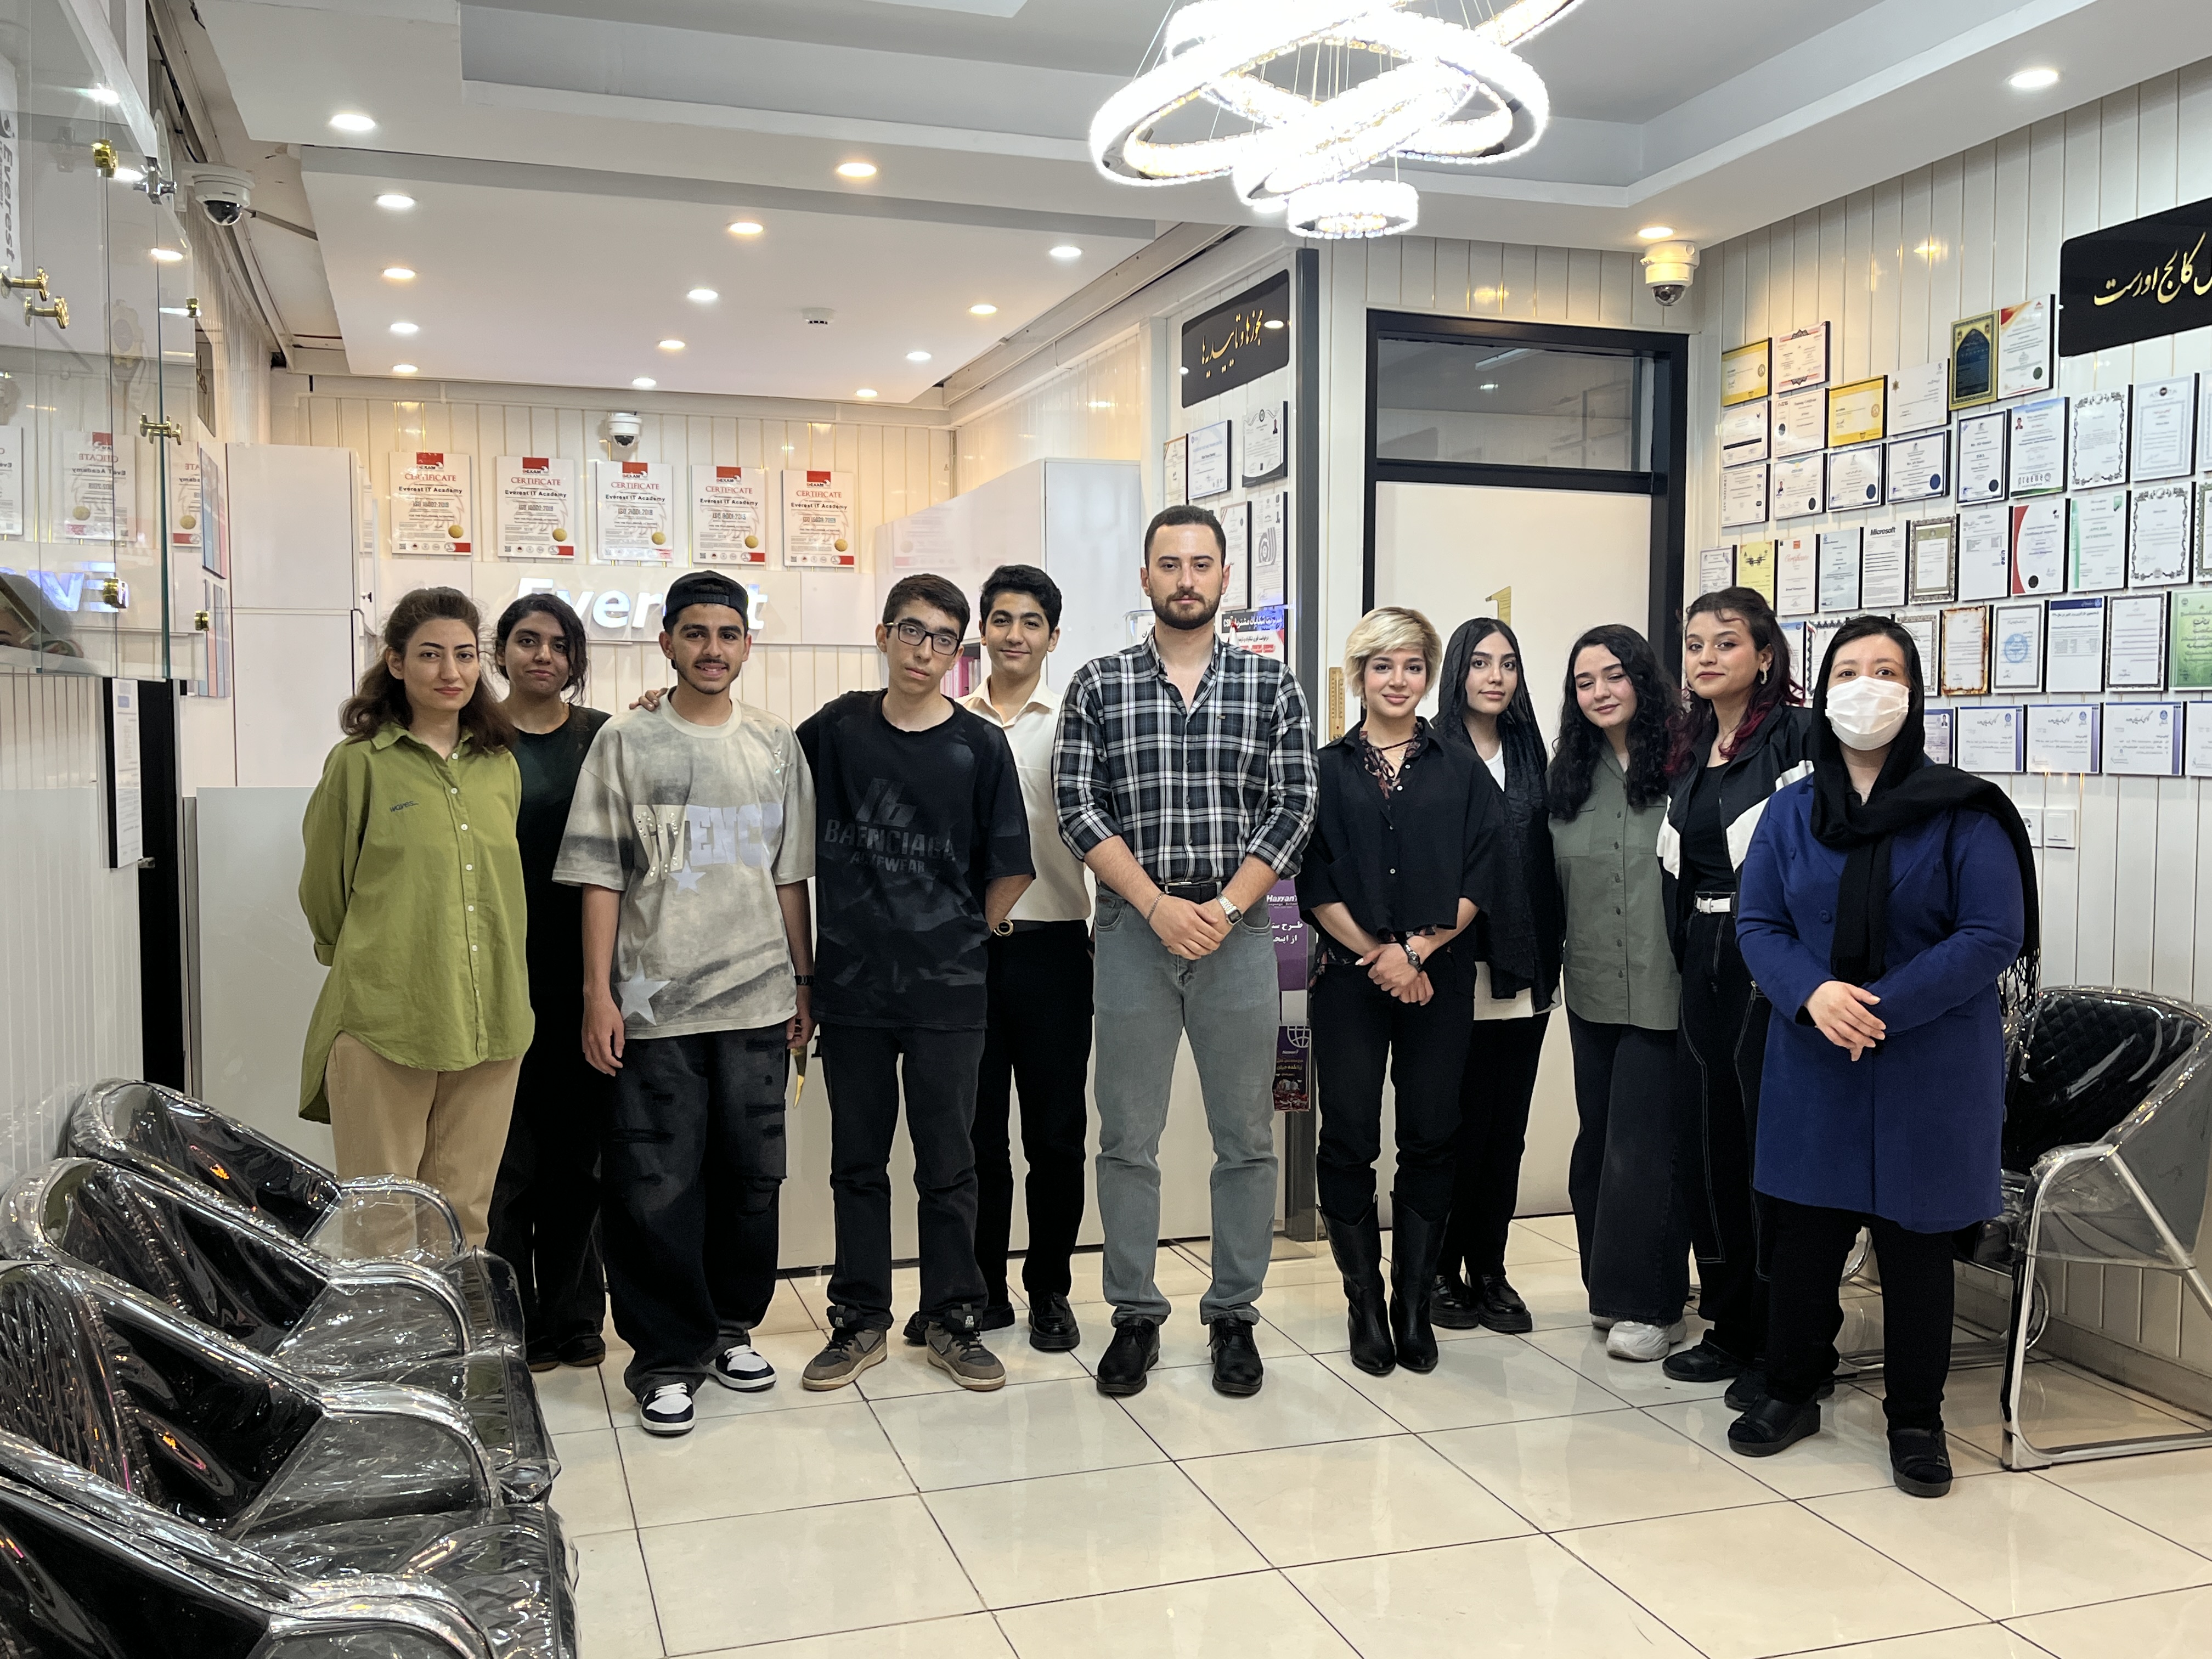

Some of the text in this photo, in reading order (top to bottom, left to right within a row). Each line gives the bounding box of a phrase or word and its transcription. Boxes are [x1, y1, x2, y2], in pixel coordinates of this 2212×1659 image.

[3, 144, 15, 263] Everest
[511, 477, 561, 486] CERTIFICATE
[611, 482, 659, 490] CERTIFICATE
[1870, 527, 1896, 535] Microsoft
[1282, 921, 1304, 931] طرح
[1290, 934, 1297, 944] از
